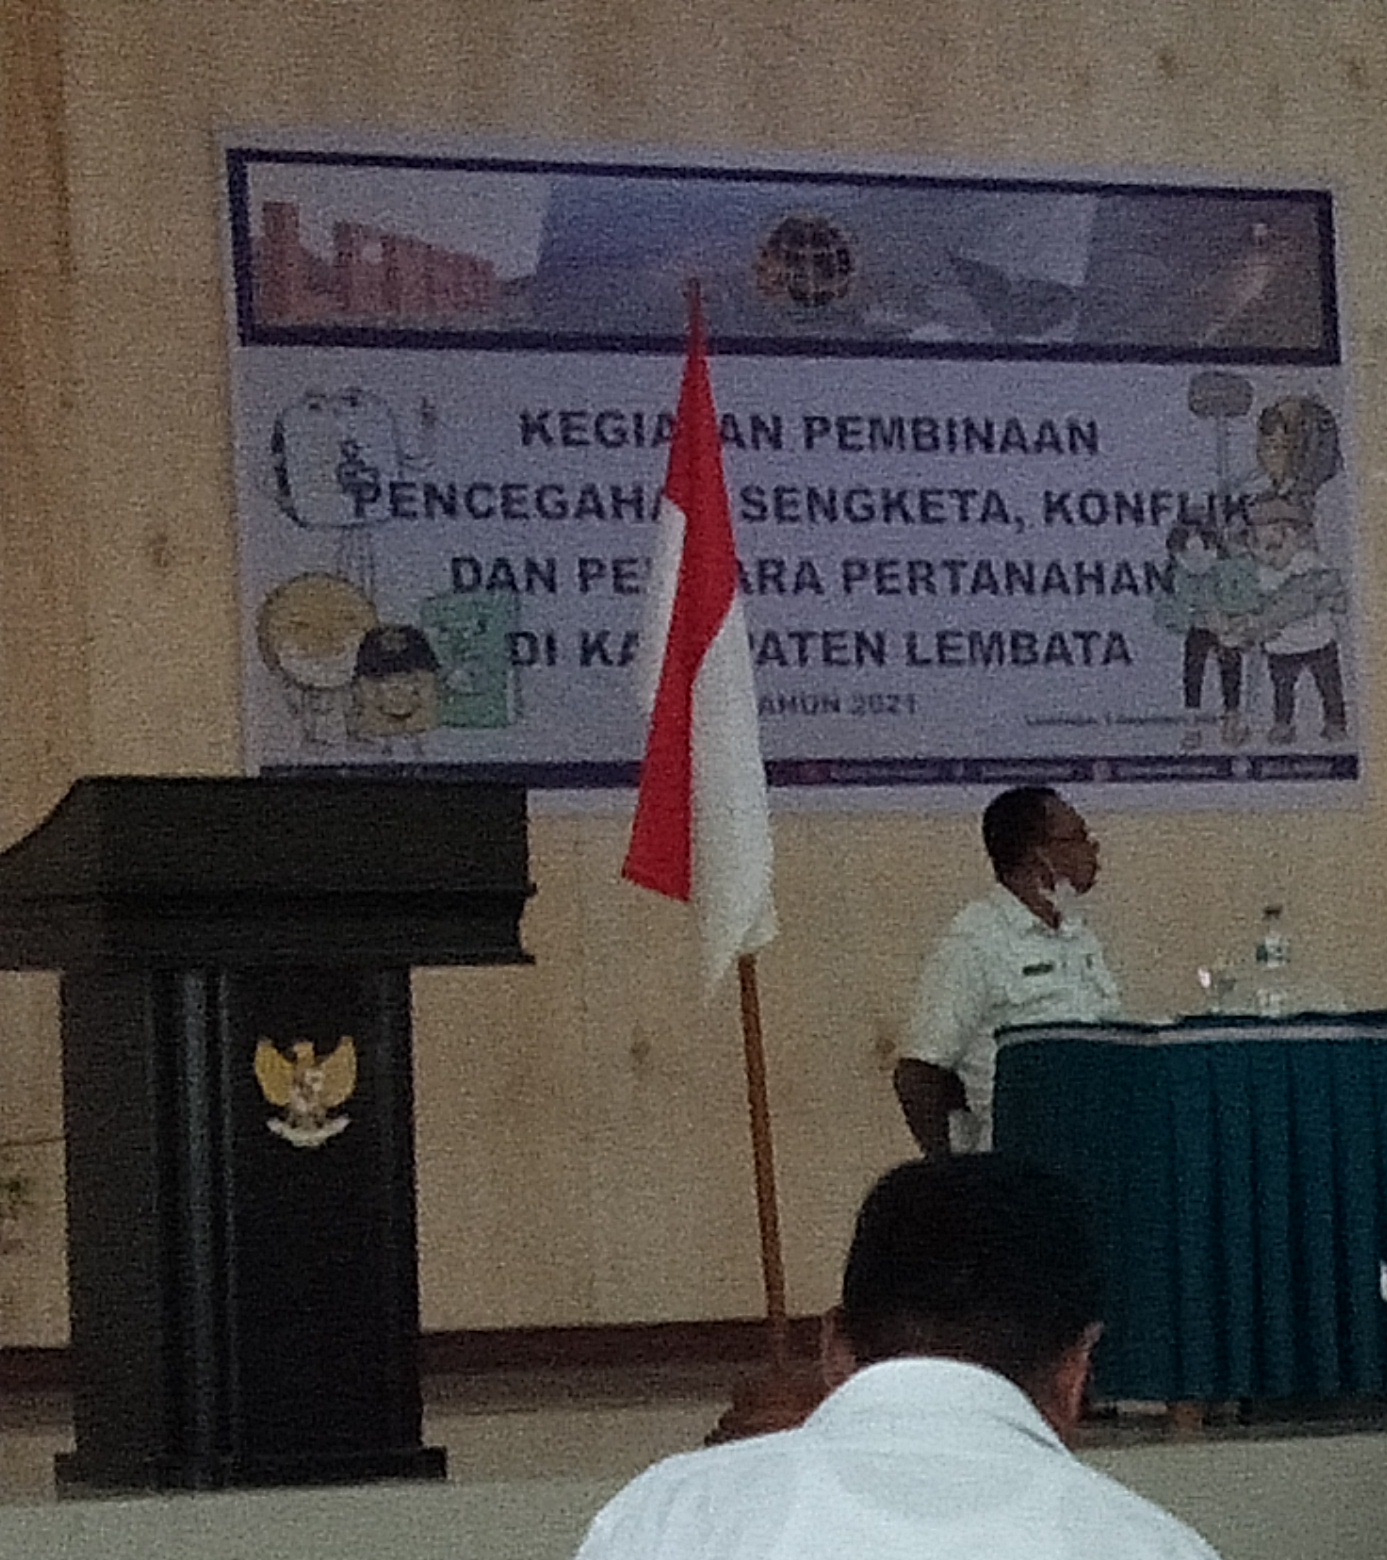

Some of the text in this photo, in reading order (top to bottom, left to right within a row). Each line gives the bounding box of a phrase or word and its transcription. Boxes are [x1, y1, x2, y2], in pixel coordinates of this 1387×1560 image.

[519, 409, 1099, 456] KEGIAAN PEMBINAAN
[353, 481, 1252, 536] PENCEGAH SENGKETA, KONFLIK
[452, 556, 558, 594] DAN
[842, 557, 1176, 597] PERTANAHAN
[507, 630, 557, 667] DI
[905, 630, 1134, 668] LEMBATA
[757, 693, 841, 717] AHUN
